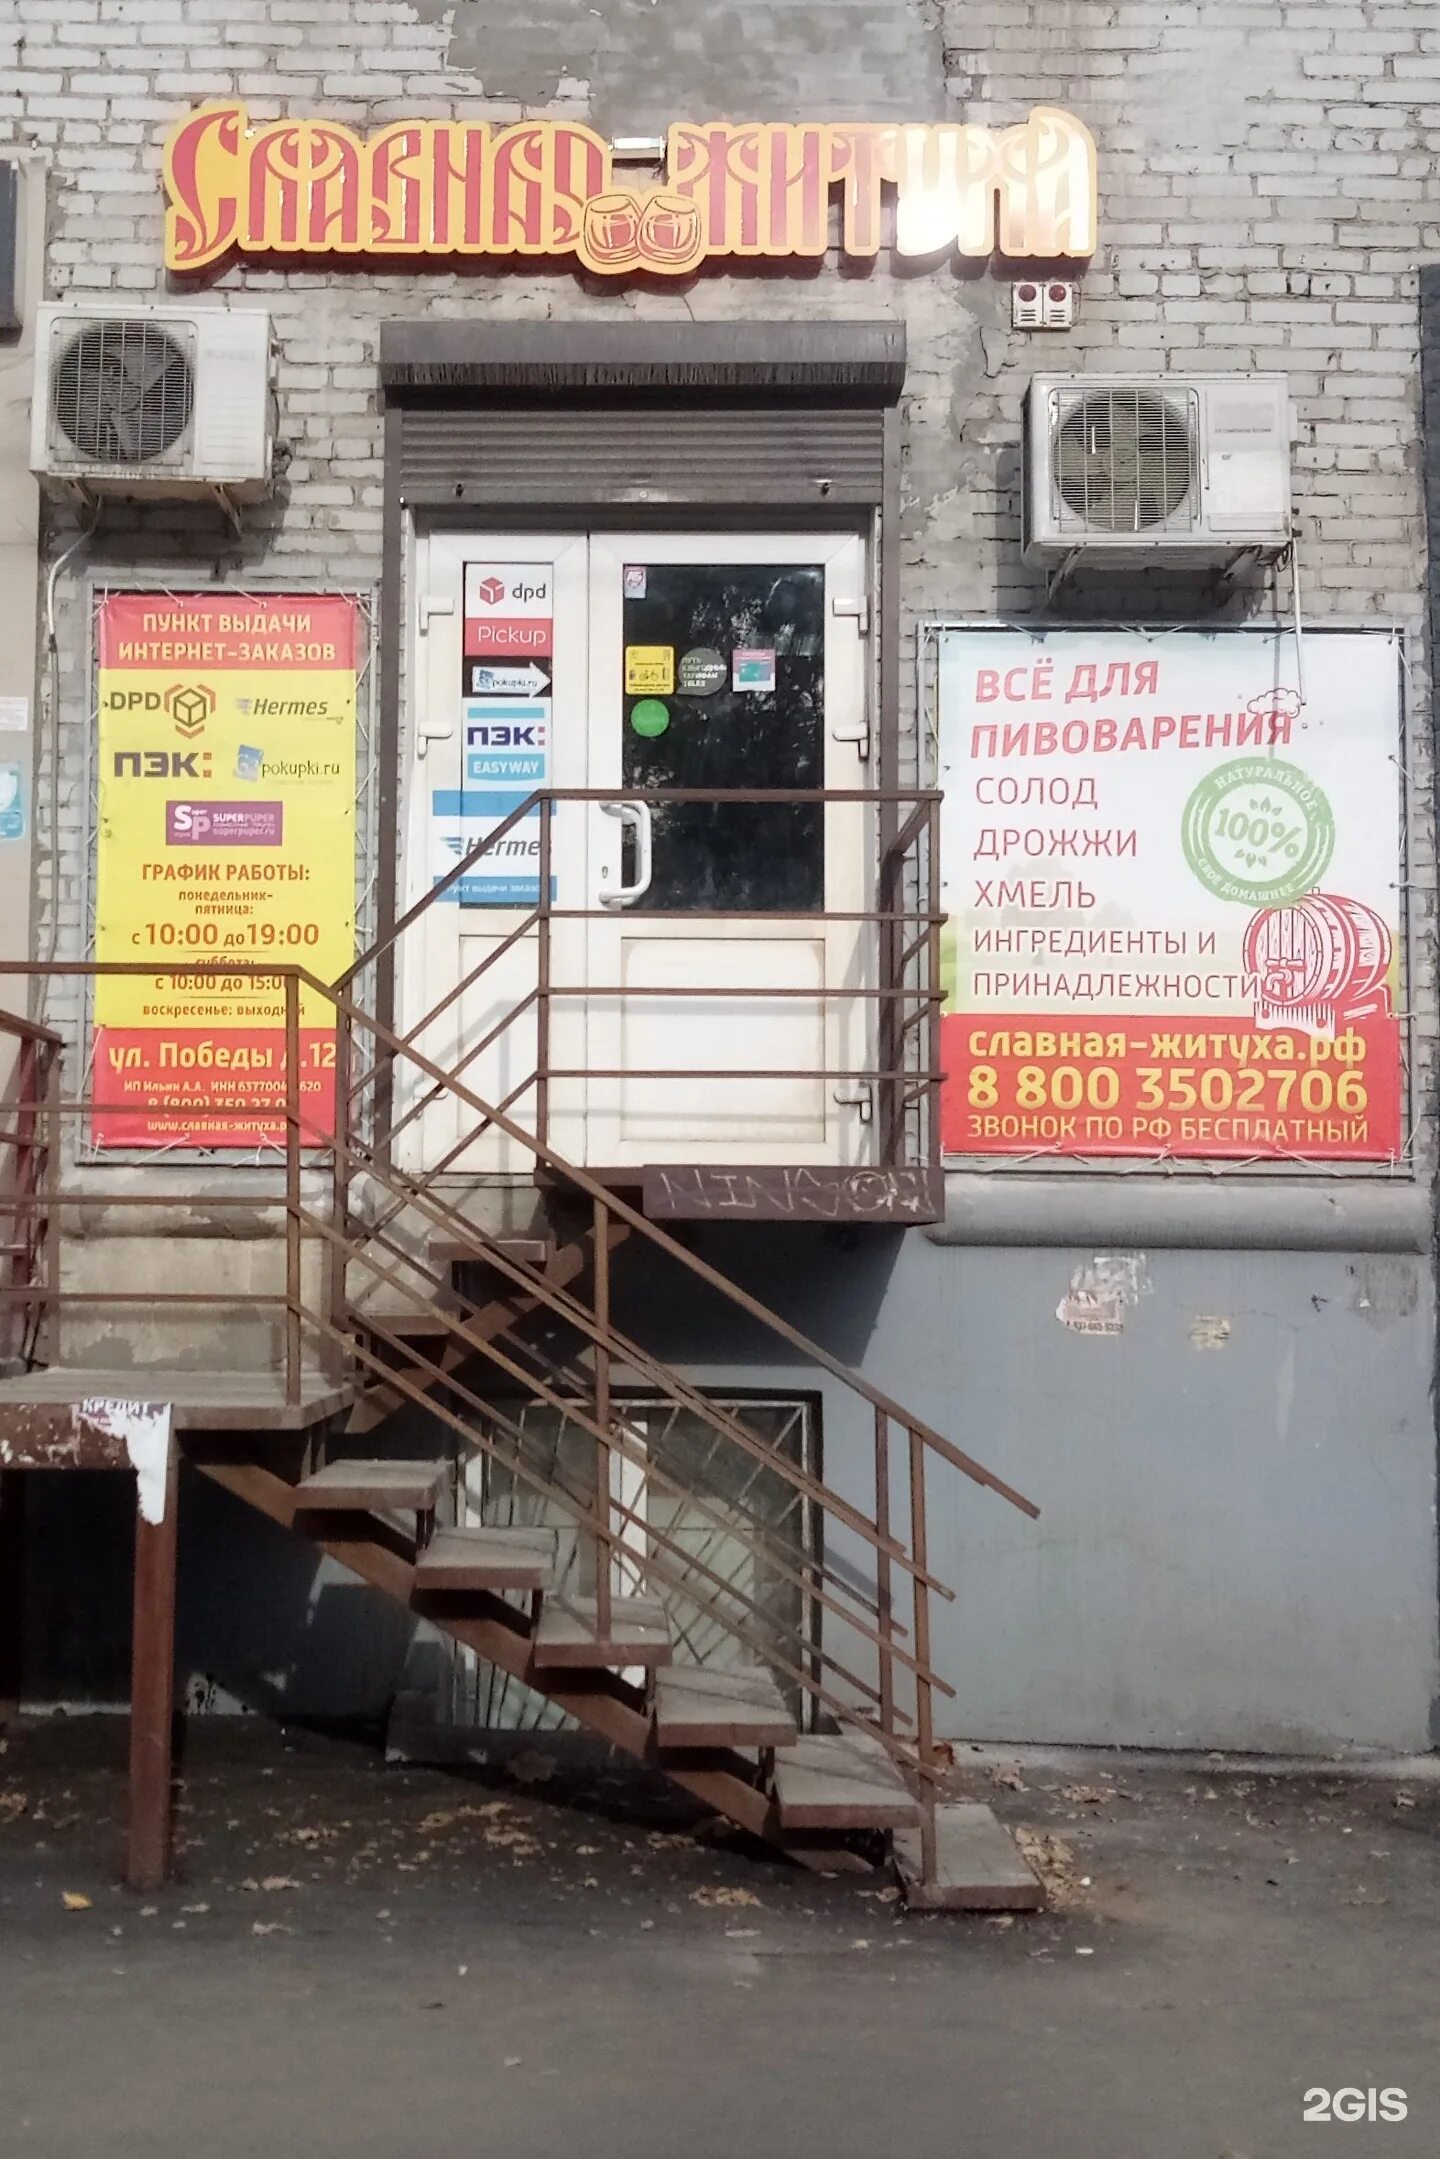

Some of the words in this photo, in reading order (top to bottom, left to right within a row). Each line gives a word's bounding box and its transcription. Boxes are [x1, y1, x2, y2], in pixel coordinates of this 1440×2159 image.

[512, 582, 546, 603] dpd
[143, 614, 212, 632] ПУНКТ
[219, 614, 311, 635] ВЫДАЧИ
[478, 626, 547, 647] Pickup
[118, 642, 336, 662] ИНТЕРНЕТ-ЗАКАЗОВ
[975, 658, 1054, 703] ВСЁ
[1064, 660, 1159, 704] ДЛЯ
[110, 691, 162, 711] DPD
[253, 698, 329, 716] Hermes
[970, 713, 1292, 758] ПИВОВАРЕНИЯ
[976, 777, 1098, 810] СОЛОД
[973, 829, 1138, 861] ДРОЖЖИ
[1215, 807, 1302, 858] 100%
[142, 864, 221, 882] ГРАФИК
[226, 864, 310, 881] РАБОТЫ:
[178, 891, 273, 902] понедельник-
[974, 881, 1096, 909] ХМЕЛЬ
[195, 904, 254, 916] пятница:
[132, 932, 140, 945] с
[145, 923, 219, 946] 10:00
[224, 932, 245, 948] до
[247, 923, 320, 946] 19:00
[974, 930, 1187, 959] ИНГРЕДИЕНТЫ
[1198, 931, 1216, 955] И
[170, 974, 216, 990] 10:00
[221, 977, 243, 992] до
[974, 972, 1260, 1000] ПРИНАДЛЕЖНОСТИ
[143, 1004, 232, 1018] воскресенье:
[109, 1047, 150, 1074] ул.
[159, 1040, 273, 1071] Победы
[969, 1026, 1367, 1069] славная-житуха.рф
[124, 1081, 141, 1092] ИП
[143, 1081, 180, 1092] Ильин
[211, 1081, 236, 1092] ИНН
[968, 1065, 999, 1109] 8
[1016, 1066, 1120, 1111] 800
[1135, 1067, 1368, 1114] 3502706
[967, 1115, 1076, 1138] ЗВОНОК
[1085, 1116, 1122, 1140] ПО
[1132, 1116, 1171, 1141] РФ
[1181, 1115, 1368, 1143] БЕСПЛАТНЫЙ
